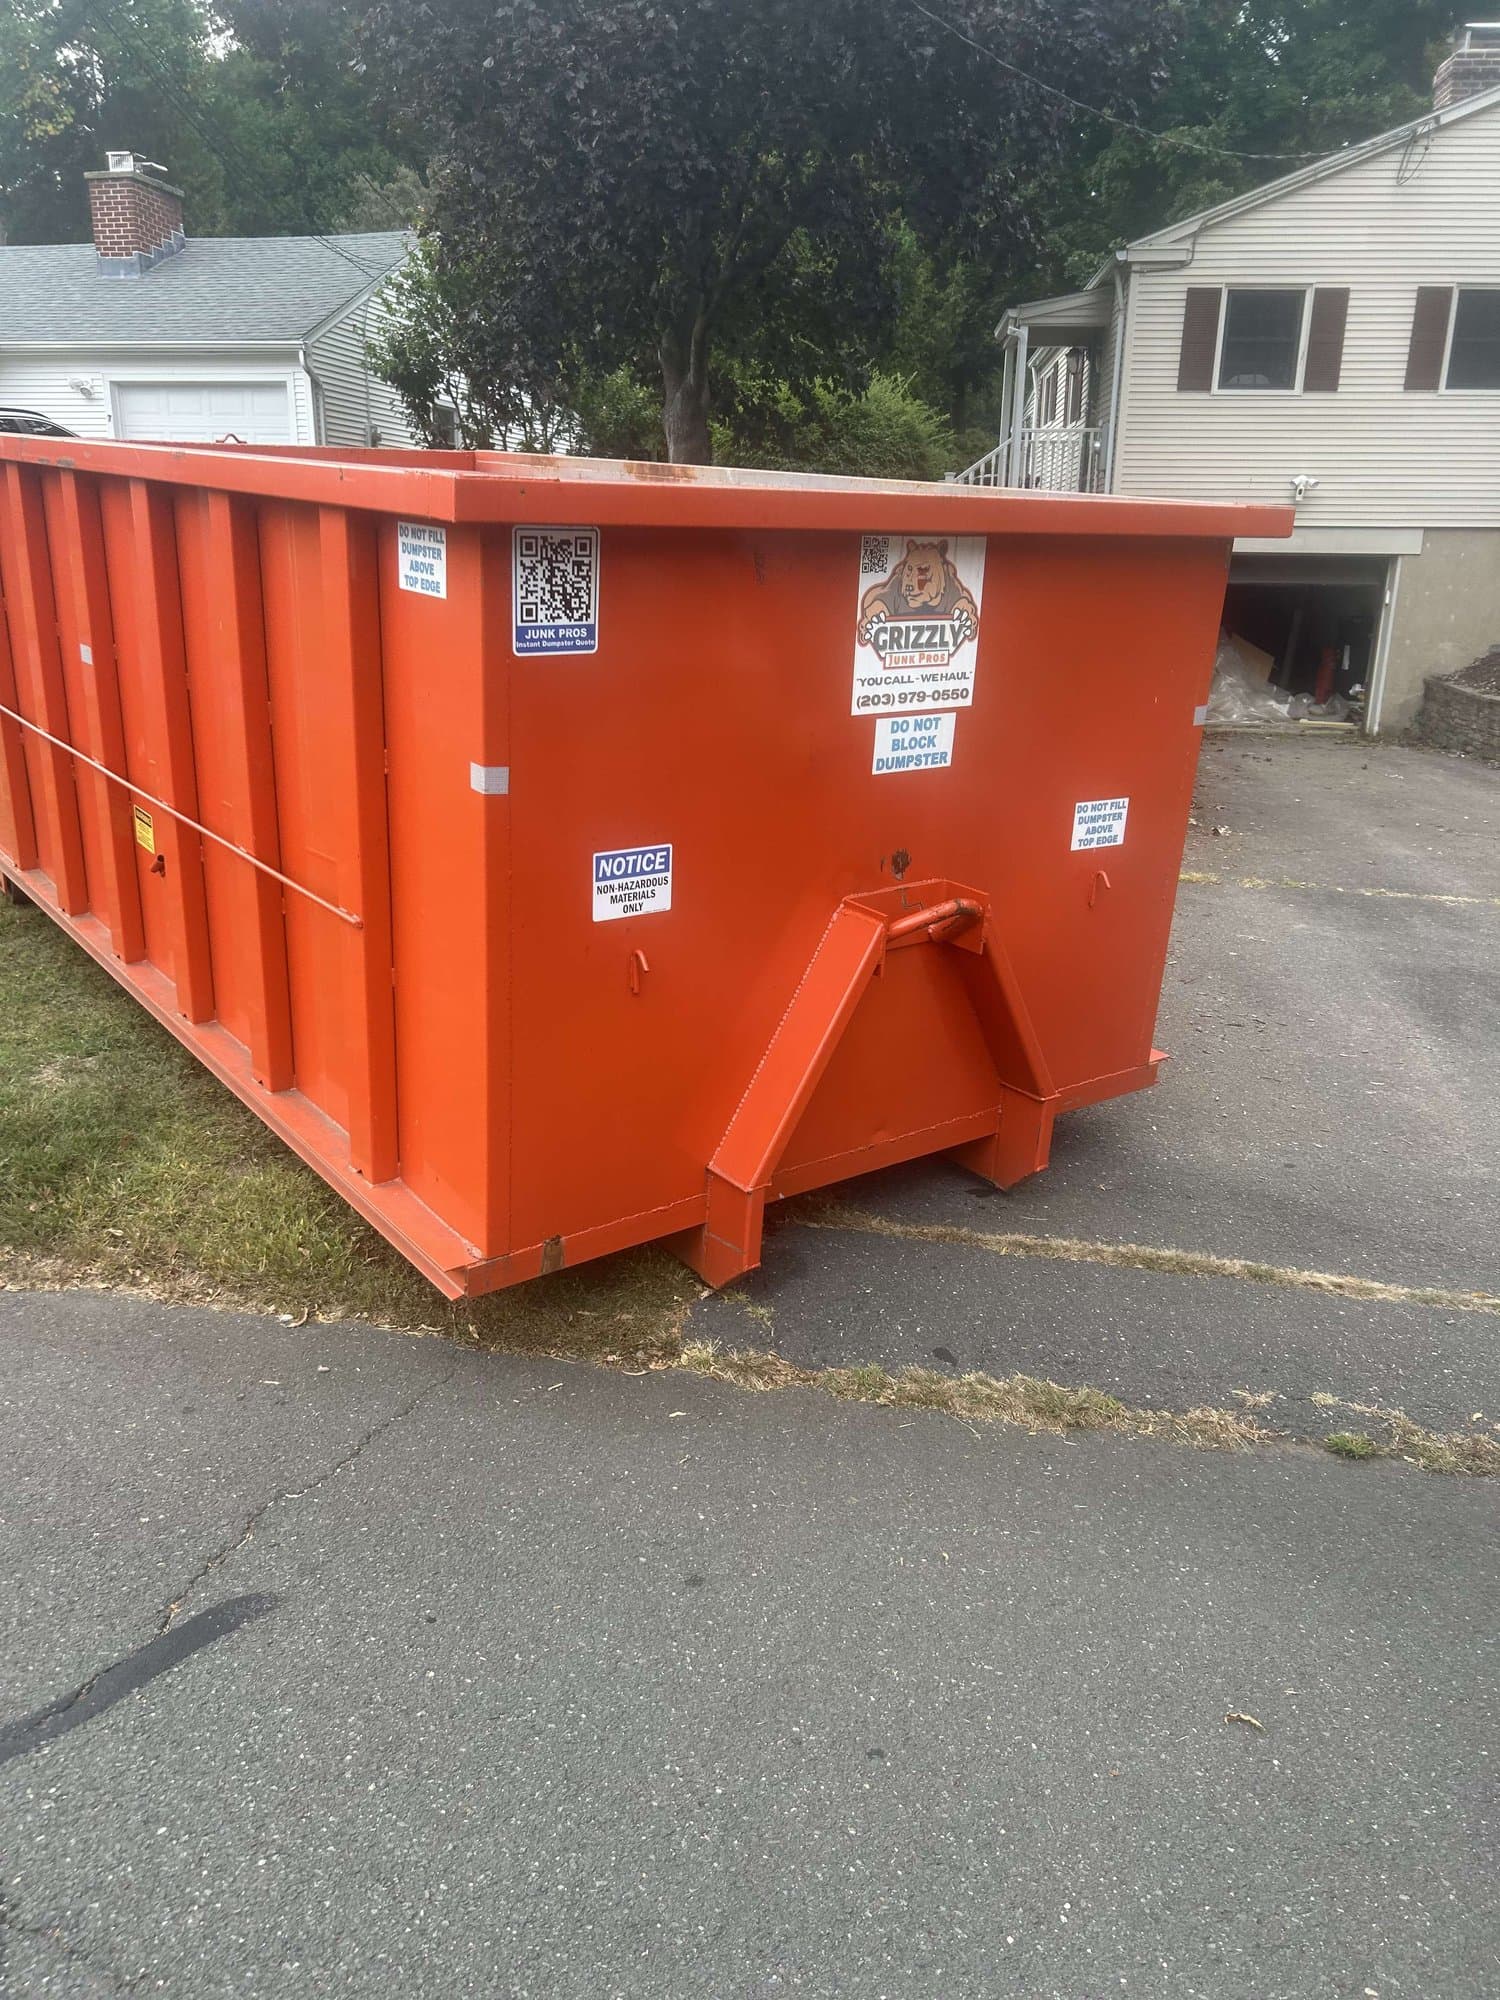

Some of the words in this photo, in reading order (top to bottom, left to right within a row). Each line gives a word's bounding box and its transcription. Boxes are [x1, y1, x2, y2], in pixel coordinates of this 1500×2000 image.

[399, 526, 409, 537] DO
[411, 527, 427, 540] NOT
[428, 530, 444, 544] FILL
[402, 542, 442, 560] DUMPSTER
[410, 560, 434, 576] ABOVE
[404, 575, 418, 588] TOP
[421, 578, 440, 593] EDGE
[525, 629, 555, 639] JUNK
[559, 628, 587, 638] PROS
[873, 624, 964, 652] GRIZZLY
[542, 640, 574, 648] Dumpster
[883, 675, 914, 685] CALL
[920, 673, 939, 682] WE
[856, 694, 895, 709] (203)
[898, 688, 969, 704] 979-0550
[891, 720, 909, 734] DO
[913, 717, 941, 732] NOT
[891, 735, 937, 752] BLOCK
[876, 751, 948, 771] DUMPSTER
[1077, 805, 1088, 814] DO
[1090, 802, 1108, 812] NOT
[1110, 800, 1126, 810] FILL
[1078, 812, 1122, 825] DUMPSTER
[1085, 824, 1113, 836] ABOVE
[1078, 838, 1094, 847] TOP
[1096, 835, 1118, 845] EDGE
[598, 851, 667, 878] NOTICE
[596, 876, 669, 895] NON-HAZARDOUS
[610, 889, 656, 904] MATERIALS
[623, 902, 643, 914] ONLY
